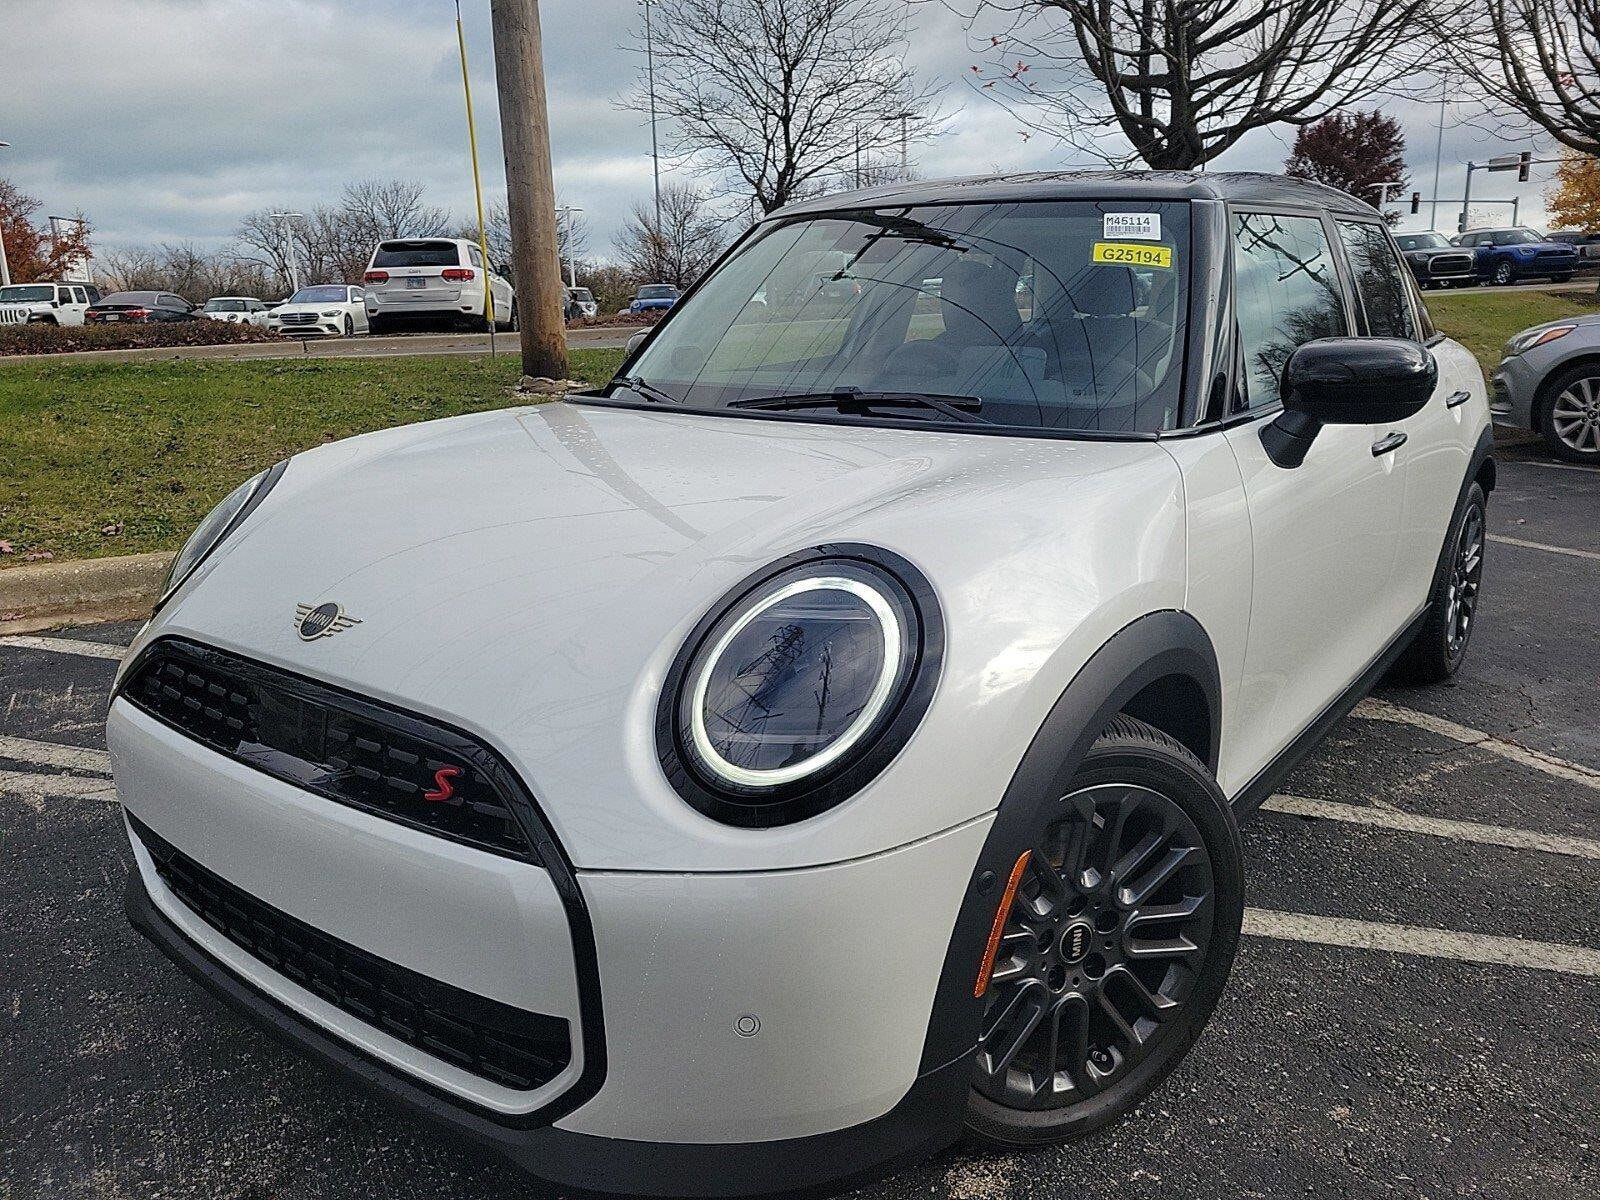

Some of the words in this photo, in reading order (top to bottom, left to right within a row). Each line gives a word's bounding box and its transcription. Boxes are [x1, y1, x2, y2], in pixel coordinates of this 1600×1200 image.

[1106, 217, 1151, 226] M45114
[1103, 248, 1162, 264] G25194
[305, 611, 333, 628] MINI
[424, 769, 458, 801] S
[1071, 928, 1083, 957] MINI
